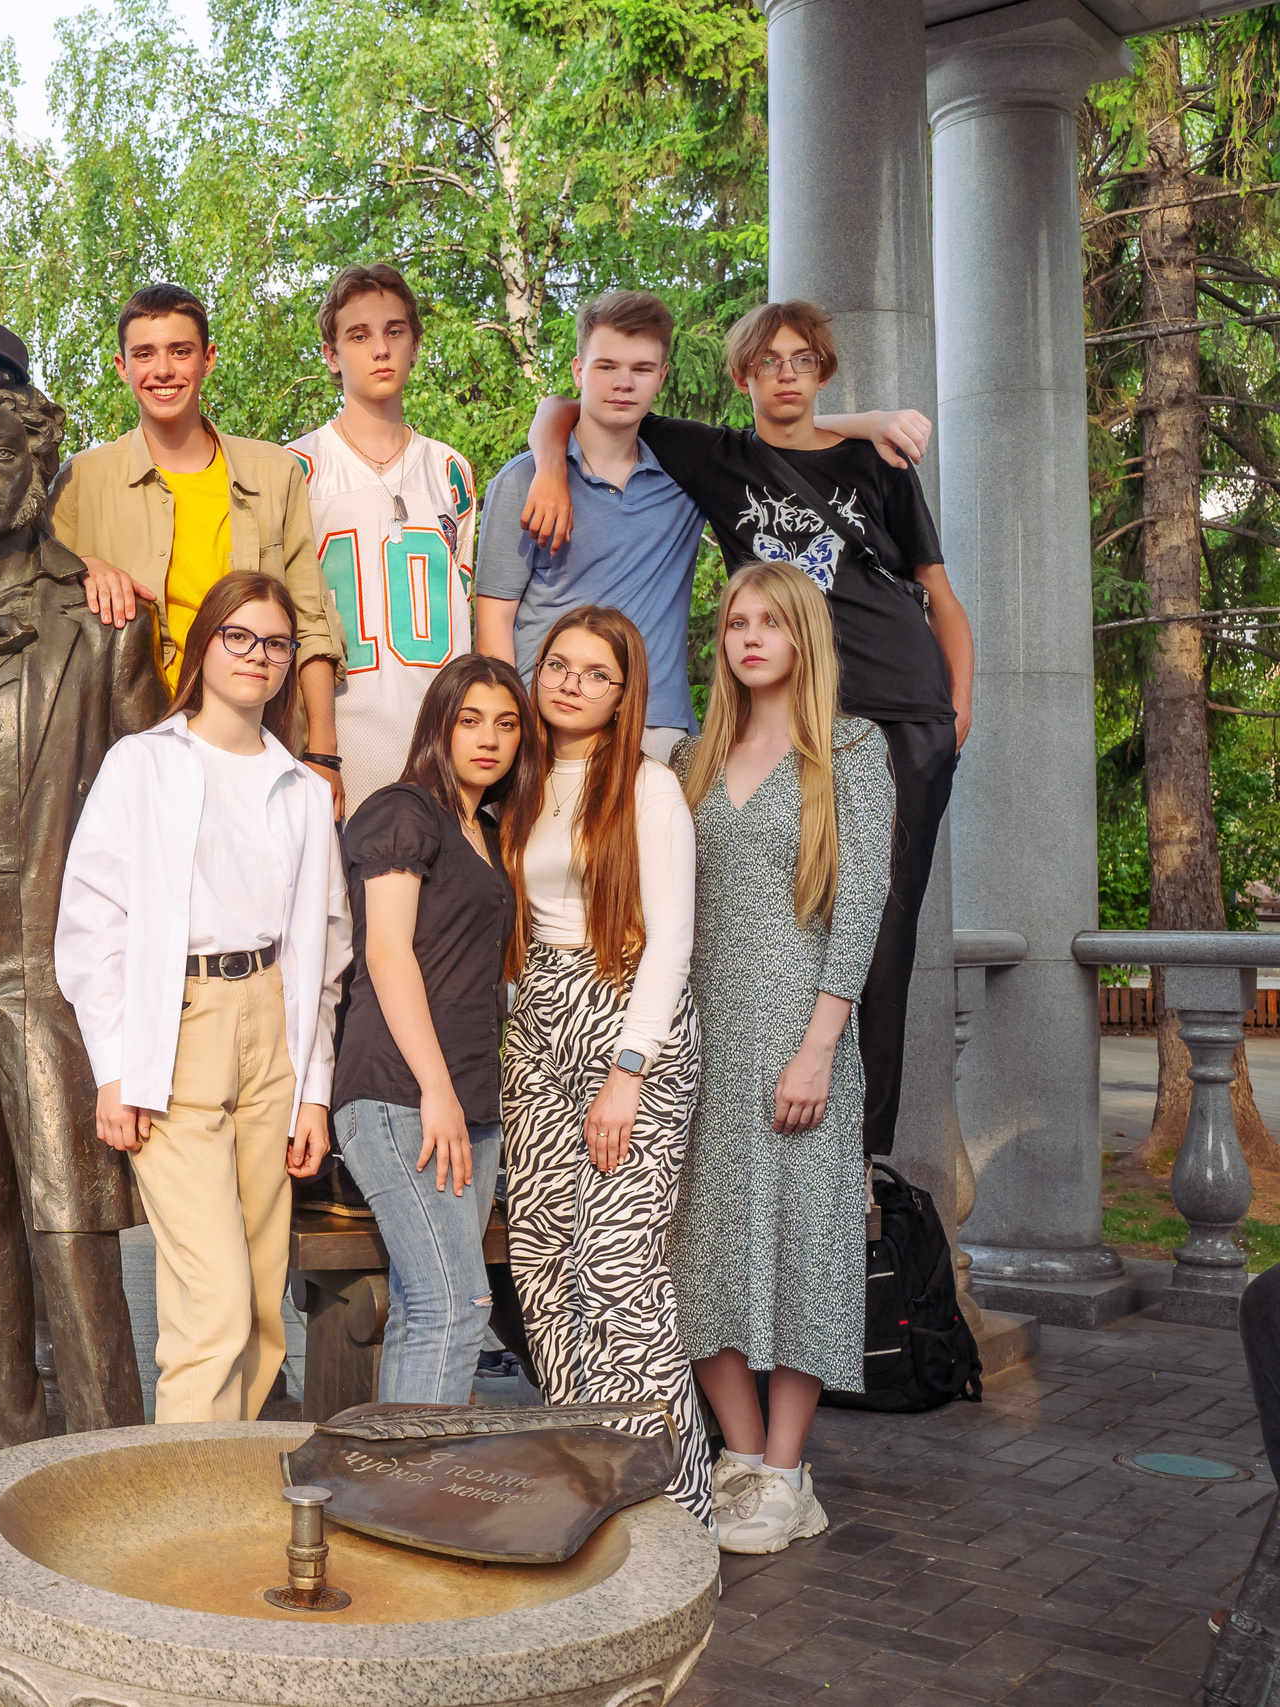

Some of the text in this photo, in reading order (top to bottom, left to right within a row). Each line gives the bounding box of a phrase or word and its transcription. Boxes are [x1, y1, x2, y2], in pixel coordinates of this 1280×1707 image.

[318, 527, 452, 675] 10
[405, 1452, 538, 1489] Я помню
